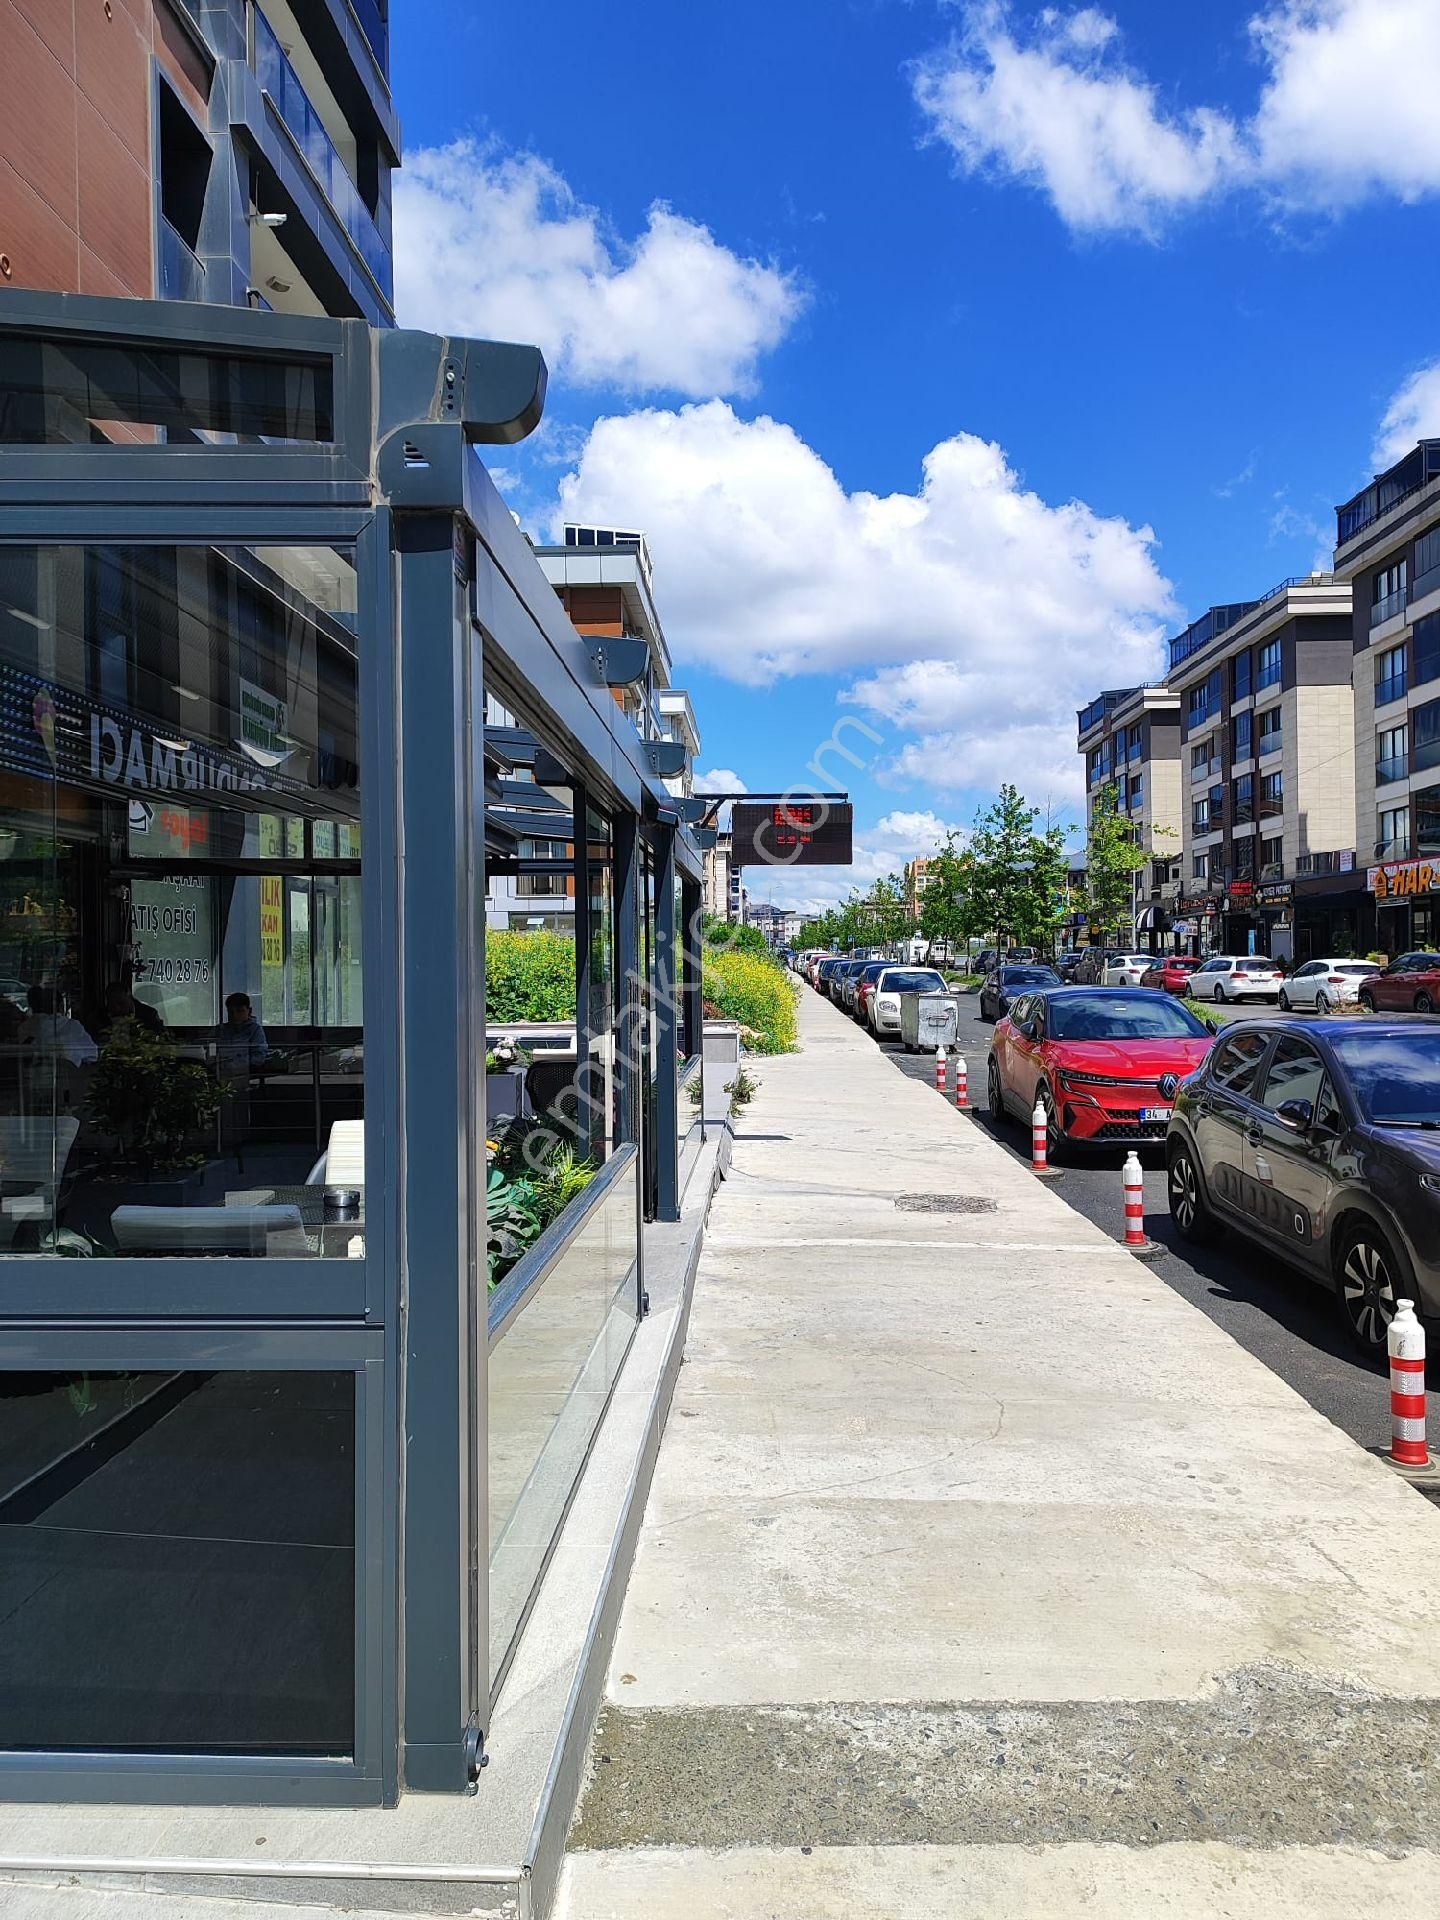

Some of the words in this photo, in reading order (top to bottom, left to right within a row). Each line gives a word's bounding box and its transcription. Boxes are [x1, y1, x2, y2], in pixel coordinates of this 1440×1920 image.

[1393, 863, 1440, 896] HAR
[162, 901, 197, 935] OFİSİ
[147, 957, 174, 983] 740
[175, 958, 192, 983] 28
[193, 958, 209, 983] 76
